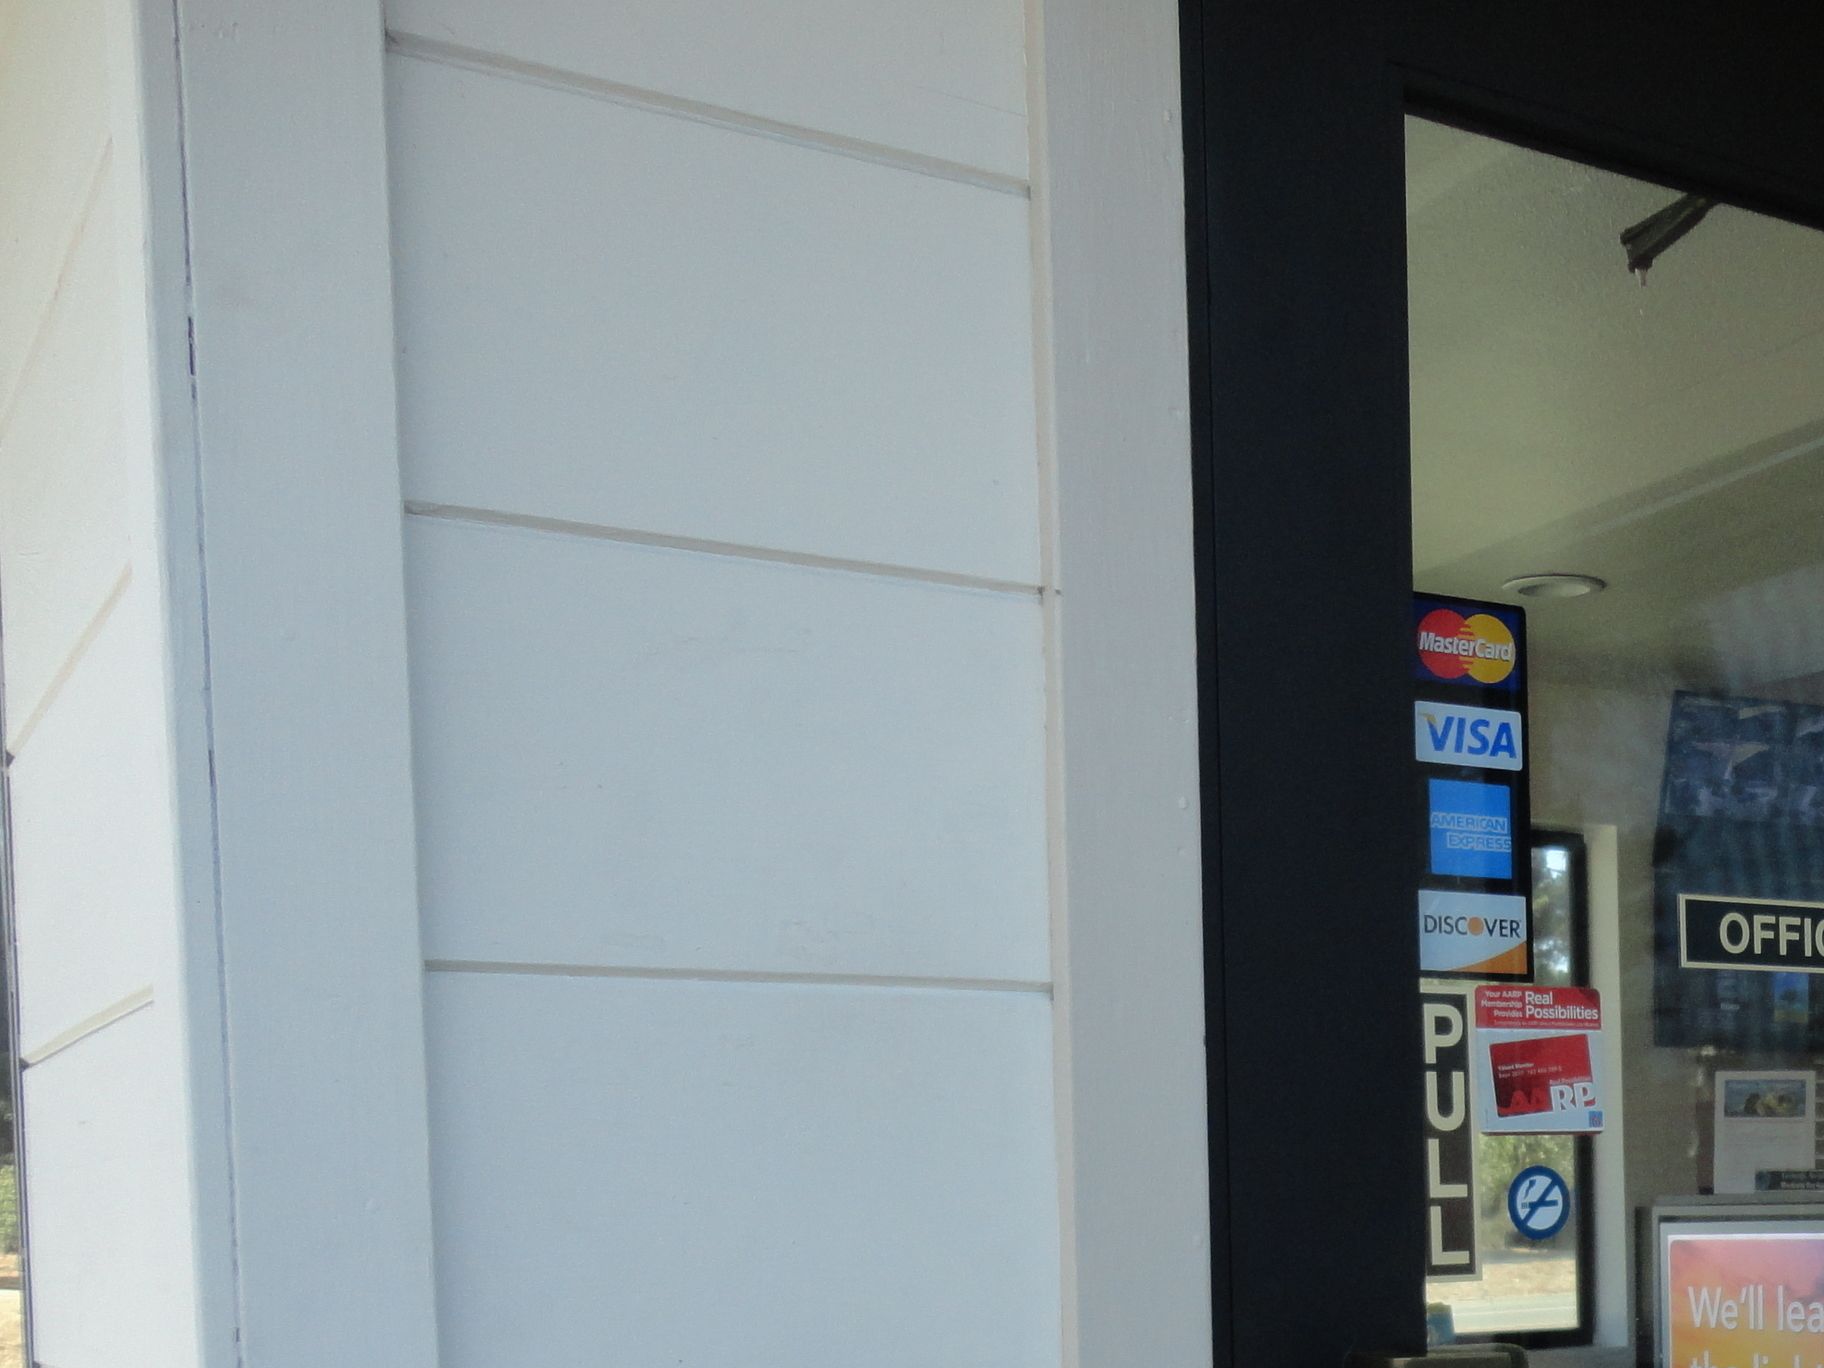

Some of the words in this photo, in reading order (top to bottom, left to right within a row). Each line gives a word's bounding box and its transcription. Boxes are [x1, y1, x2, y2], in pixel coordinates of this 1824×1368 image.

[1418, 631, 1513, 662] MasterCard
[1425, 714, 1518, 760] VISA
[1431, 812, 1506, 832] AMERICAN
[1449, 833, 1512, 851] EXPRESS
[1424, 914, 1521, 938] DISCOVER
[1525, 991, 1553, 1005] Real
[1525, 1005, 1599, 1020] Possibilities
[1424, 1003, 1470, 1265] PULL
[1688, 1285, 1764, 1331] We'll
